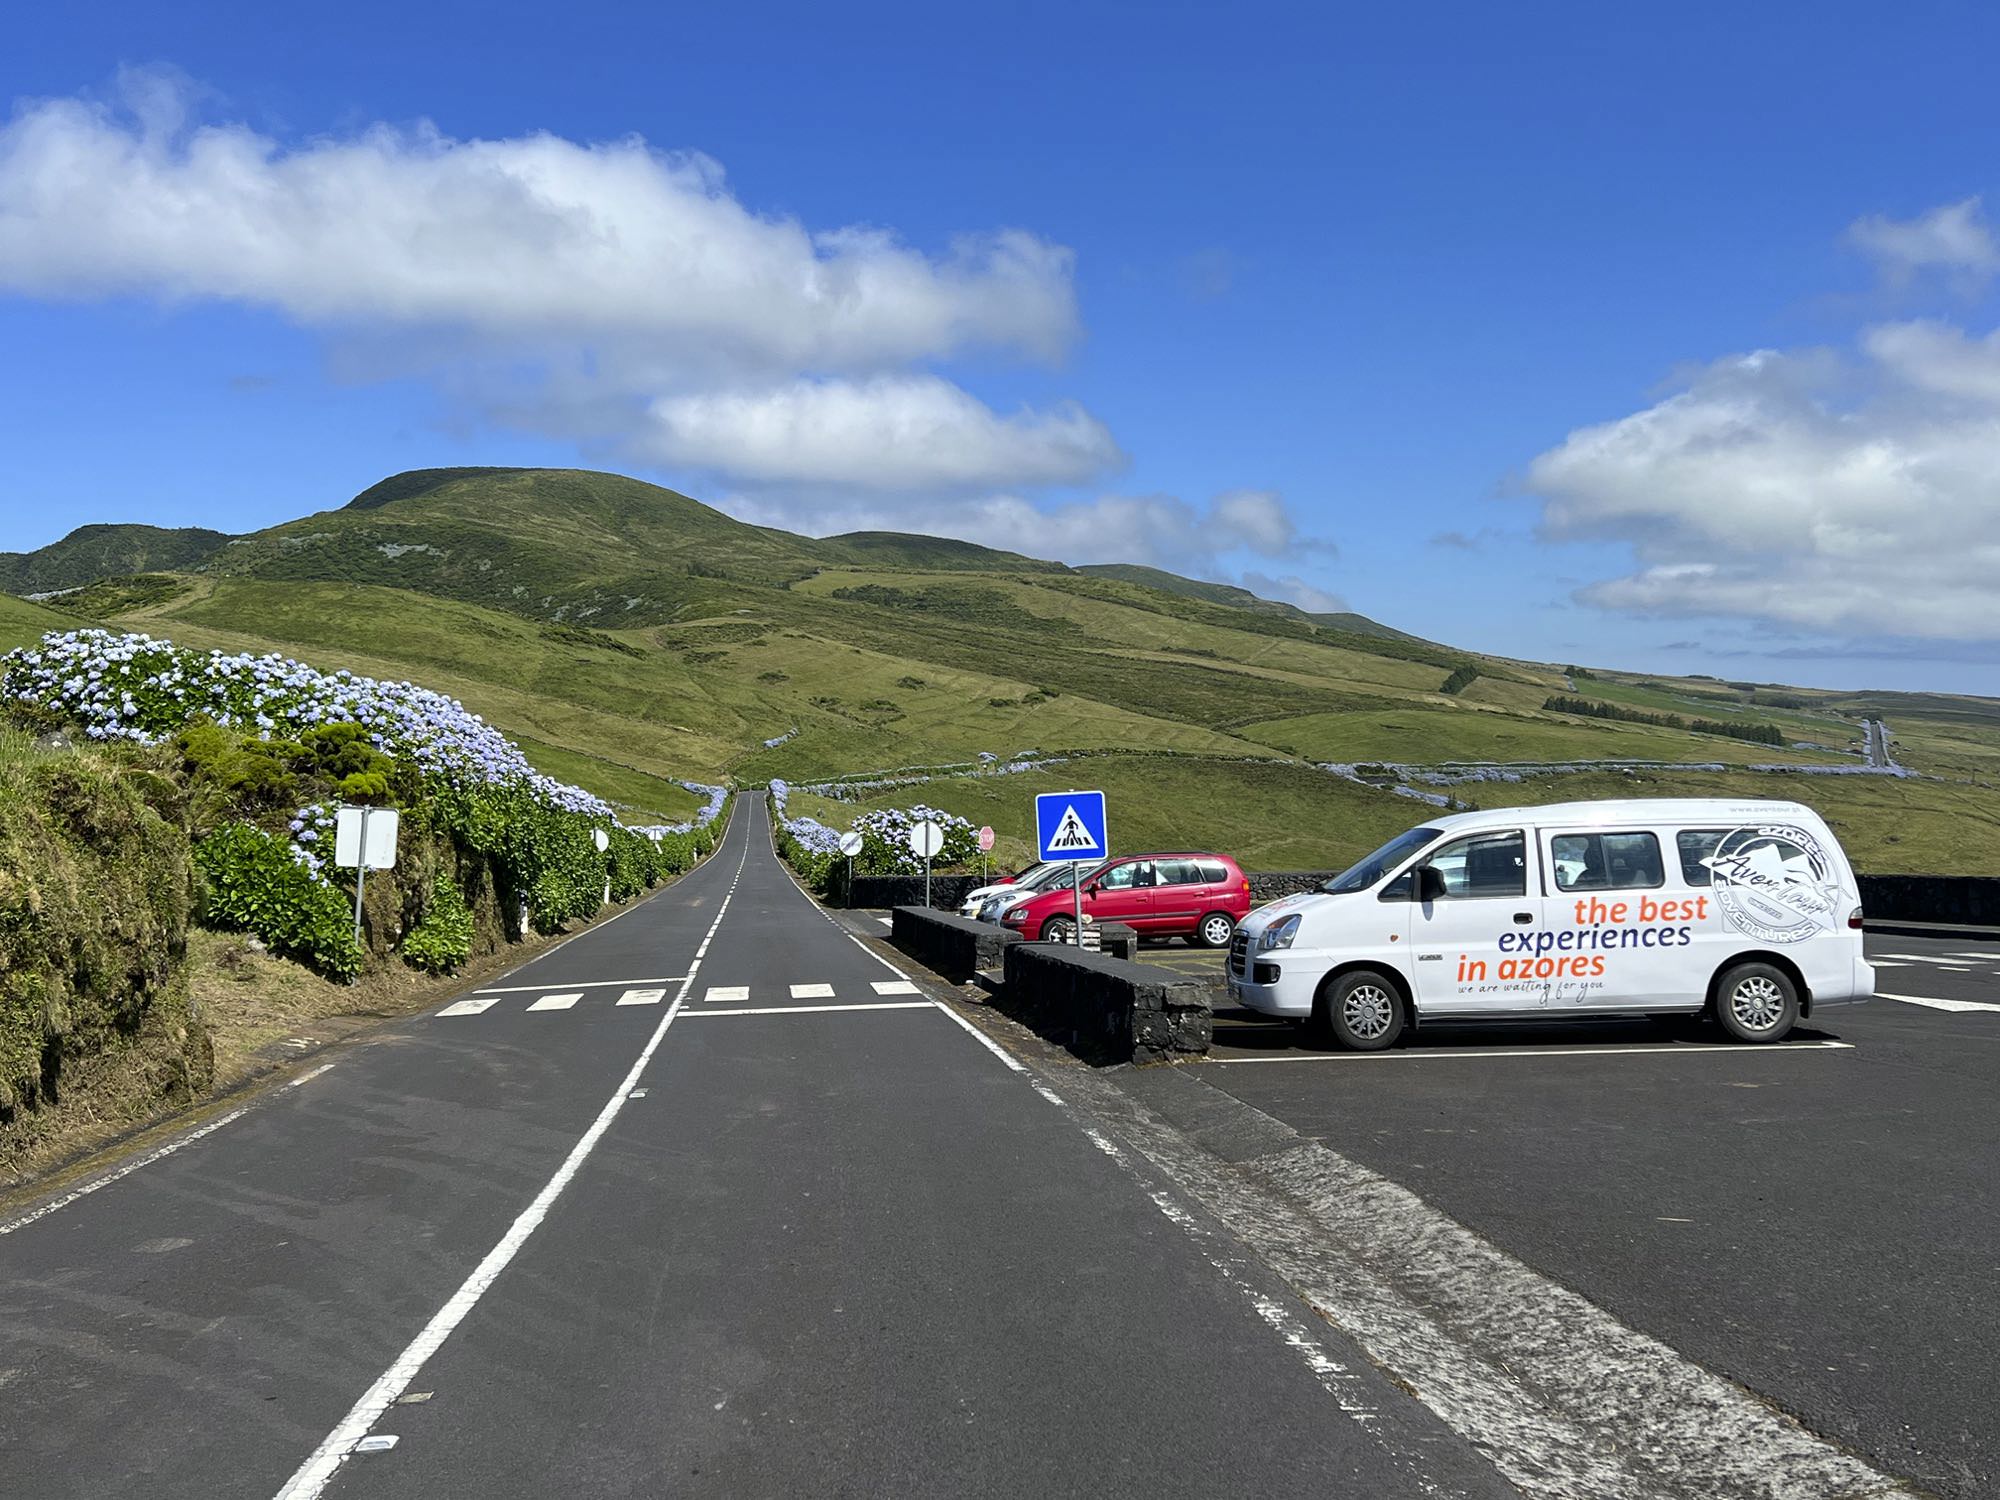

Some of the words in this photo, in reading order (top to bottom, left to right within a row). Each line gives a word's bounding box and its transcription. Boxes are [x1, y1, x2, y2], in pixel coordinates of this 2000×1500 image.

[1574, 896, 1628, 925] the
[1639, 895, 1709, 922] best
[1498, 922, 1691, 958] experiences
[1457, 954, 1487, 982] in
[1498, 954, 1605, 981] azores
[1457, 985, 1474, 994] we
[1479, 984, 1499, 993] are
[1503, 979, 1551, 1005] waiting
[1555, 981, 1576, 1000] for
[1575, 981, 1604, 1003] you
